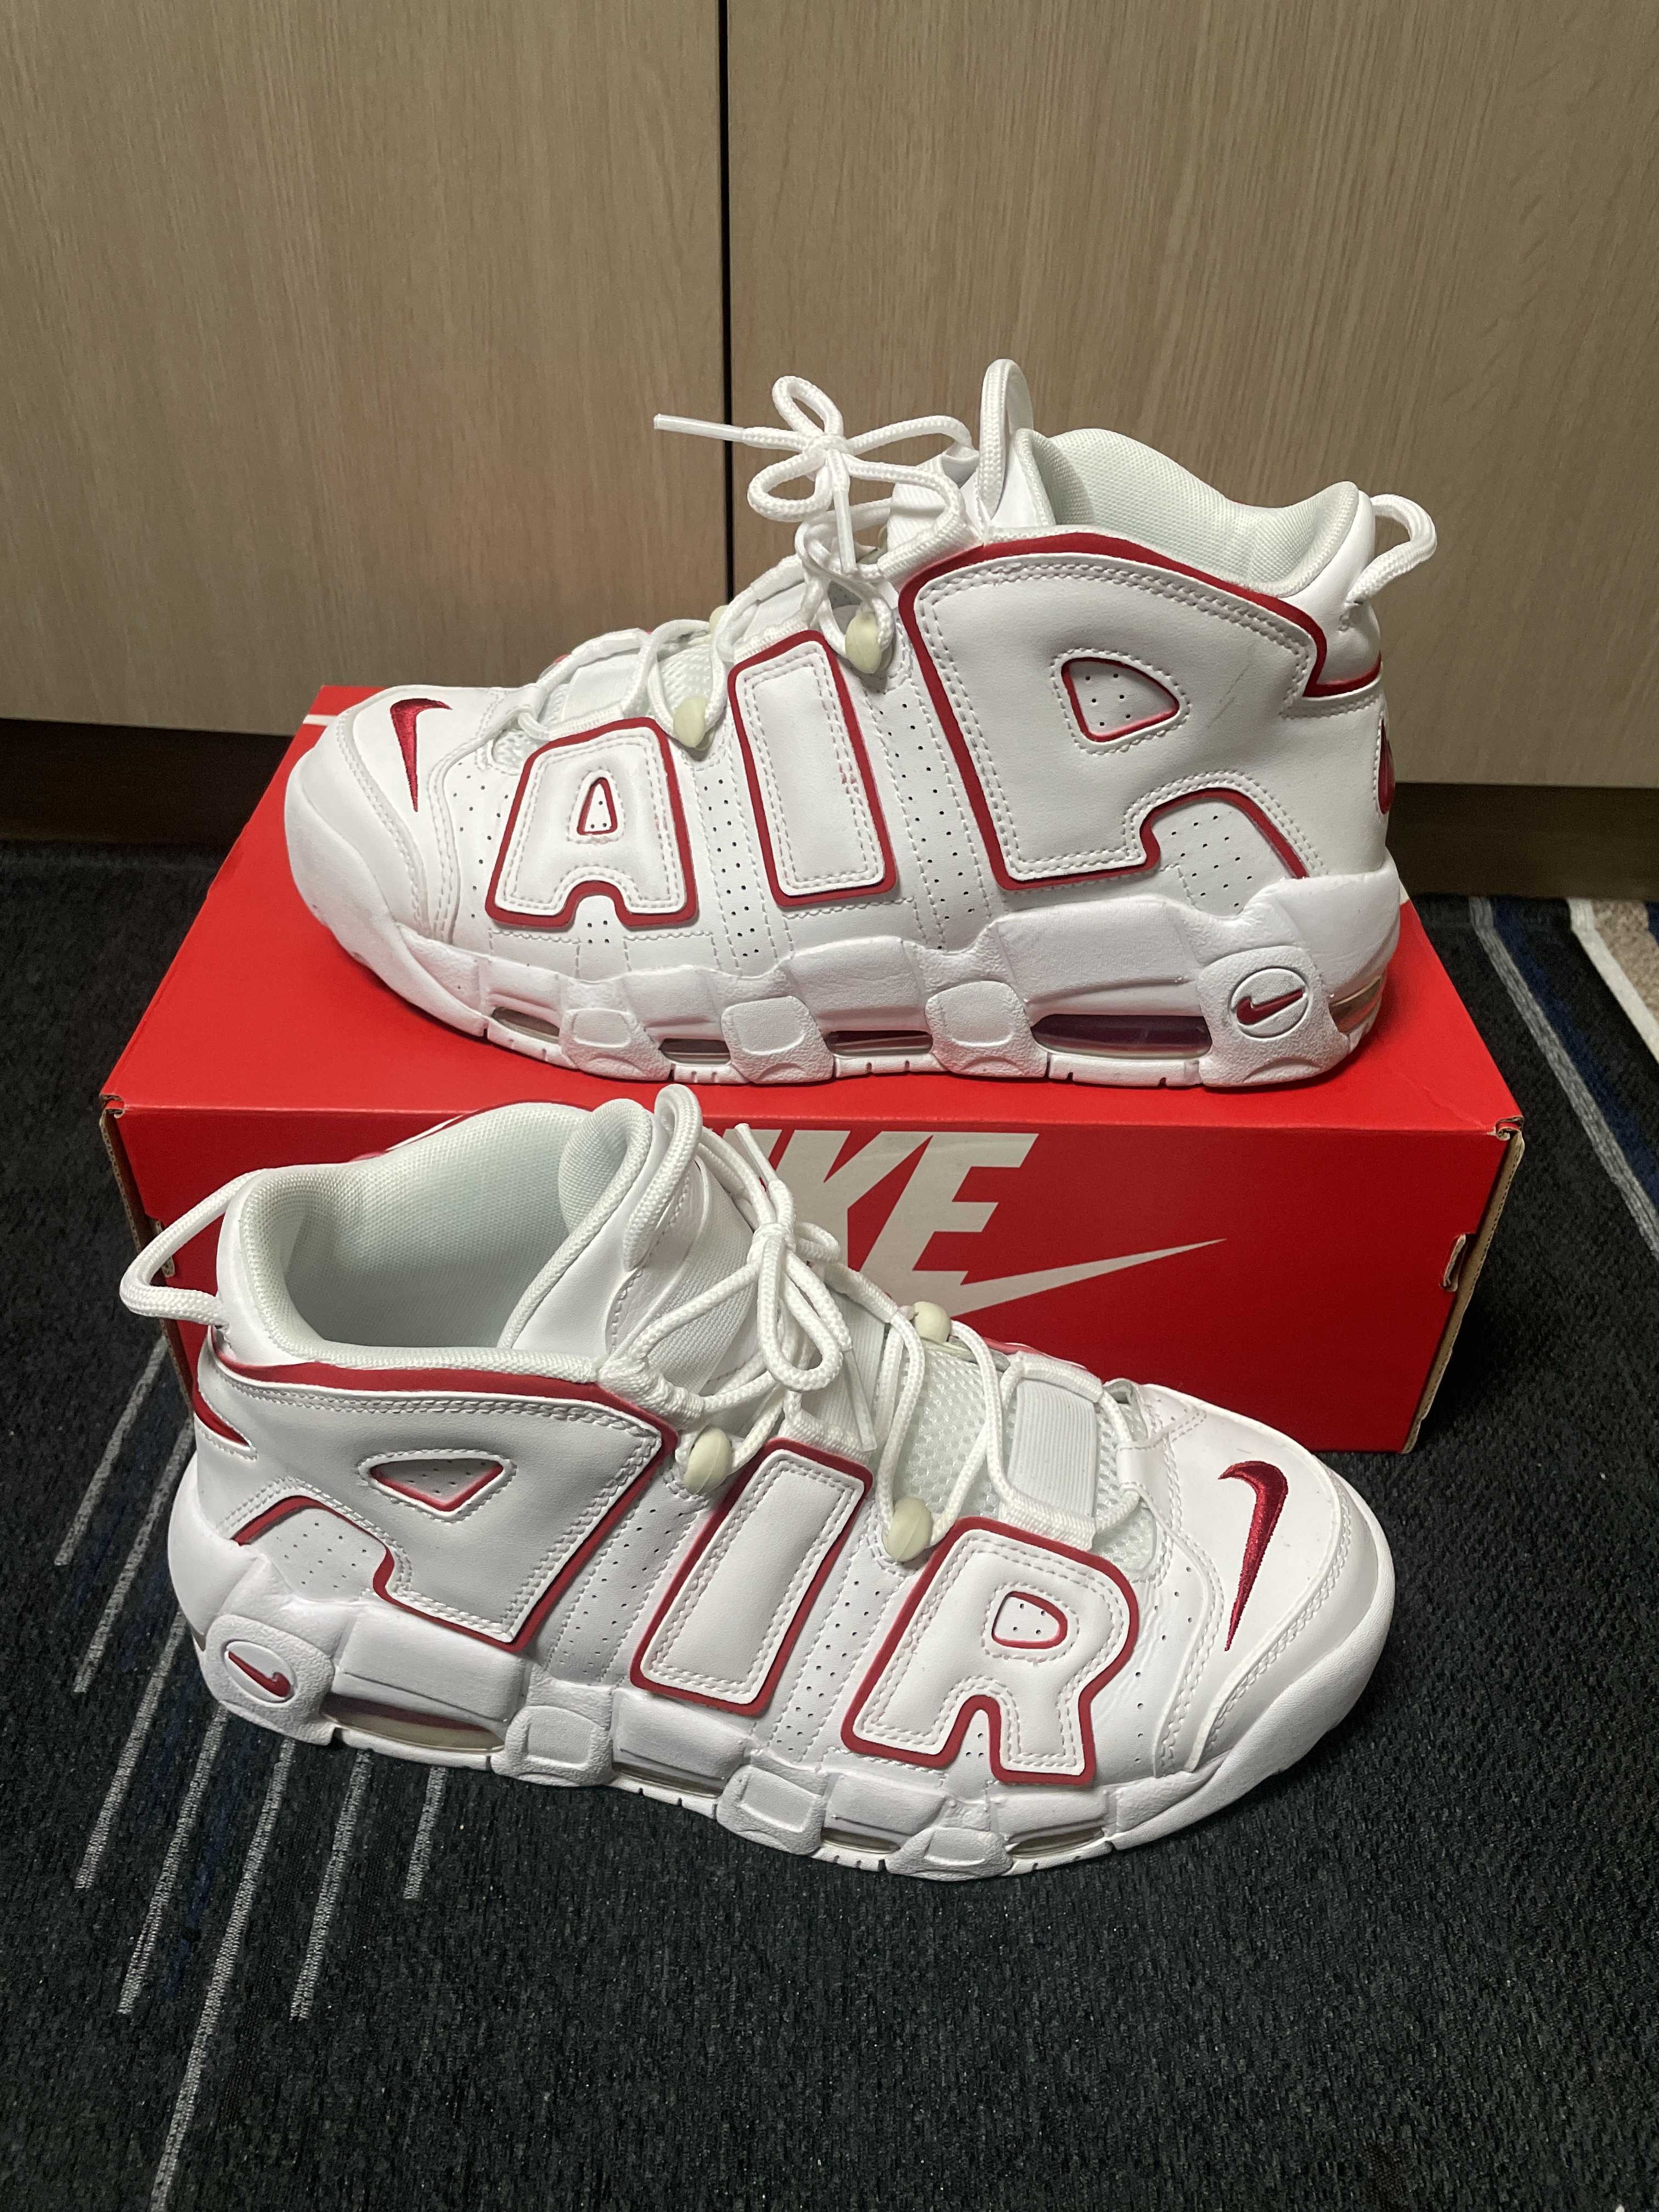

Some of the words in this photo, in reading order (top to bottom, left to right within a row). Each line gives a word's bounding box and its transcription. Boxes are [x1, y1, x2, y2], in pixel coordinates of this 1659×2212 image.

[486, 531, 1328, 927] AIR
[711, 1128, 1039, 1314] KE
[194, 1361, 1138, 1785] AIR
